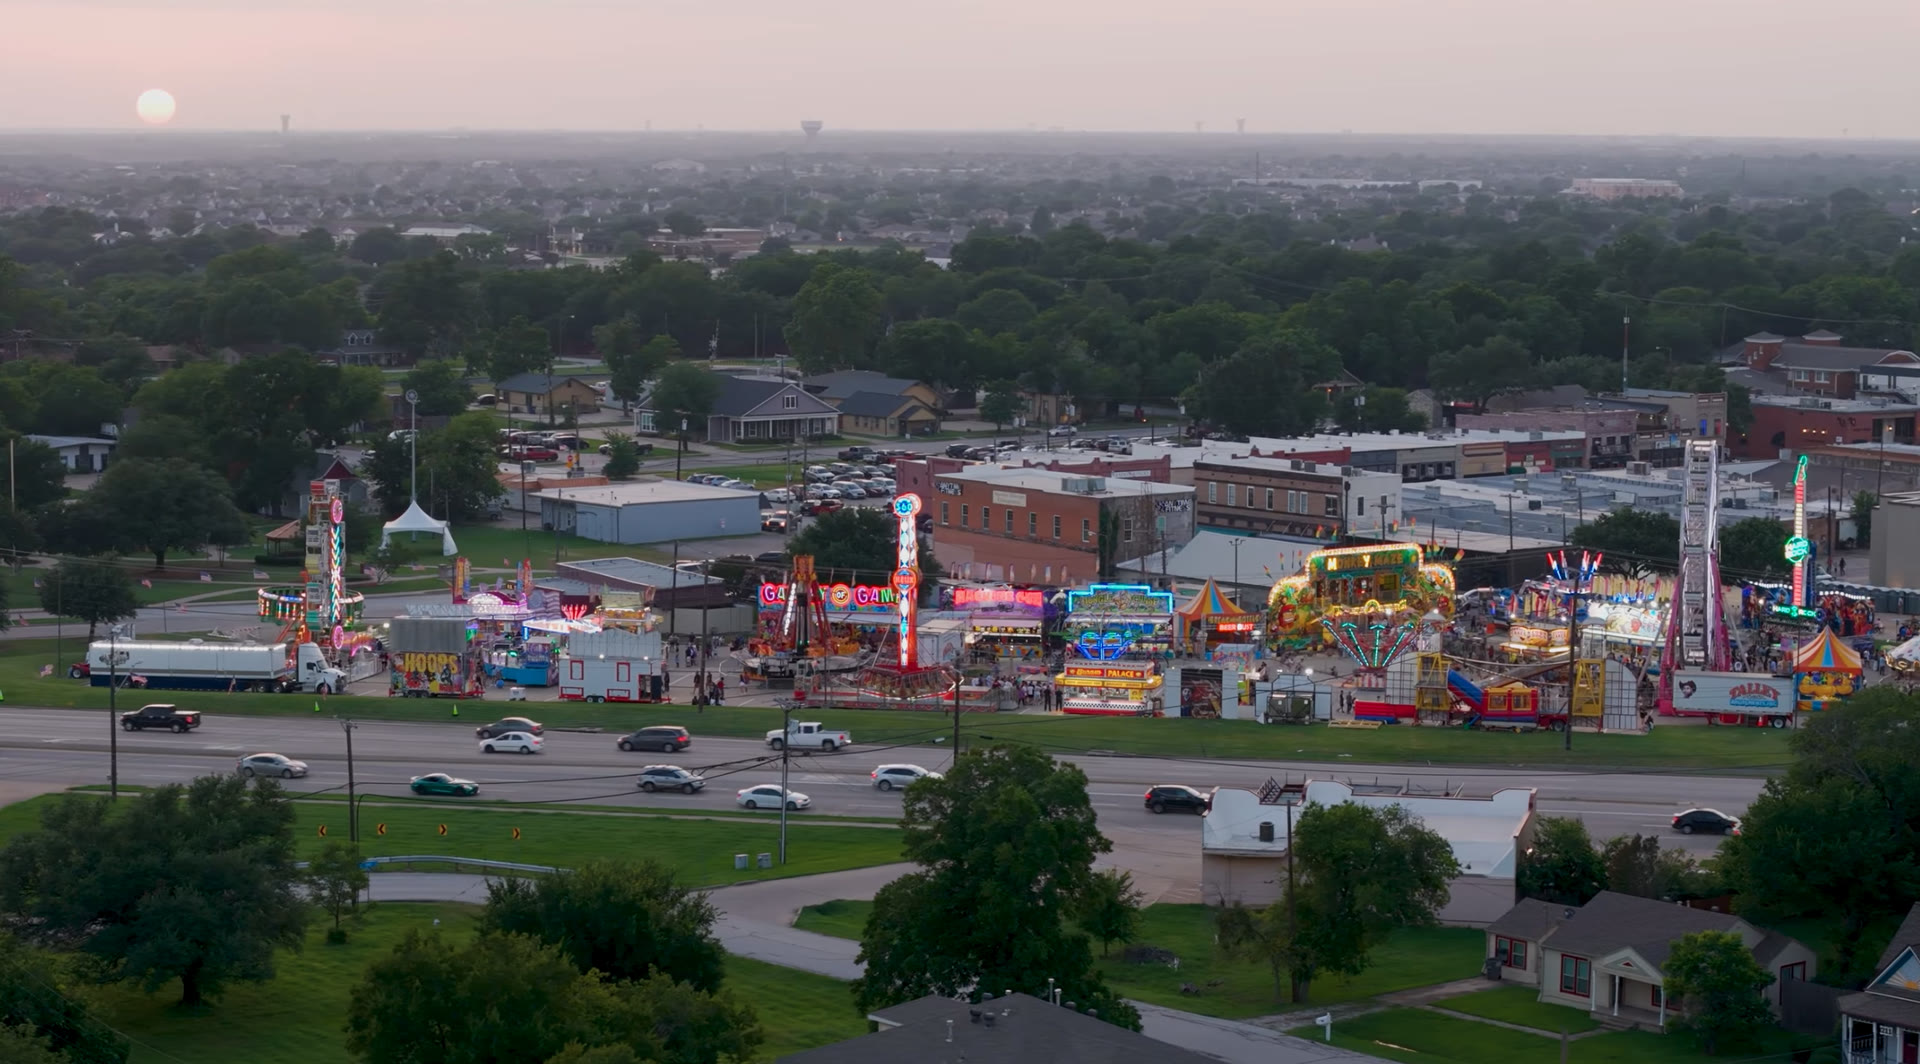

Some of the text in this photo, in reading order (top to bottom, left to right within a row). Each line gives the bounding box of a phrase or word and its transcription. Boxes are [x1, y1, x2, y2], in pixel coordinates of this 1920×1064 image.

[895, 502, 912, 511] 360
[1327, 552, 1403, 571] MONKEY MAZE
[763, 584, 826, 602] GAY
[856, 586, 899, 604] GAM
[1772, 605, 1817, 617] HARD ROCK
[1218, 623, 1237, 631] BEER
[405, 652, 458, 674] HOOPS
[1107, 669, 1134, 678] PALACE
[1729, 682, 1781, 700] TALLEY
